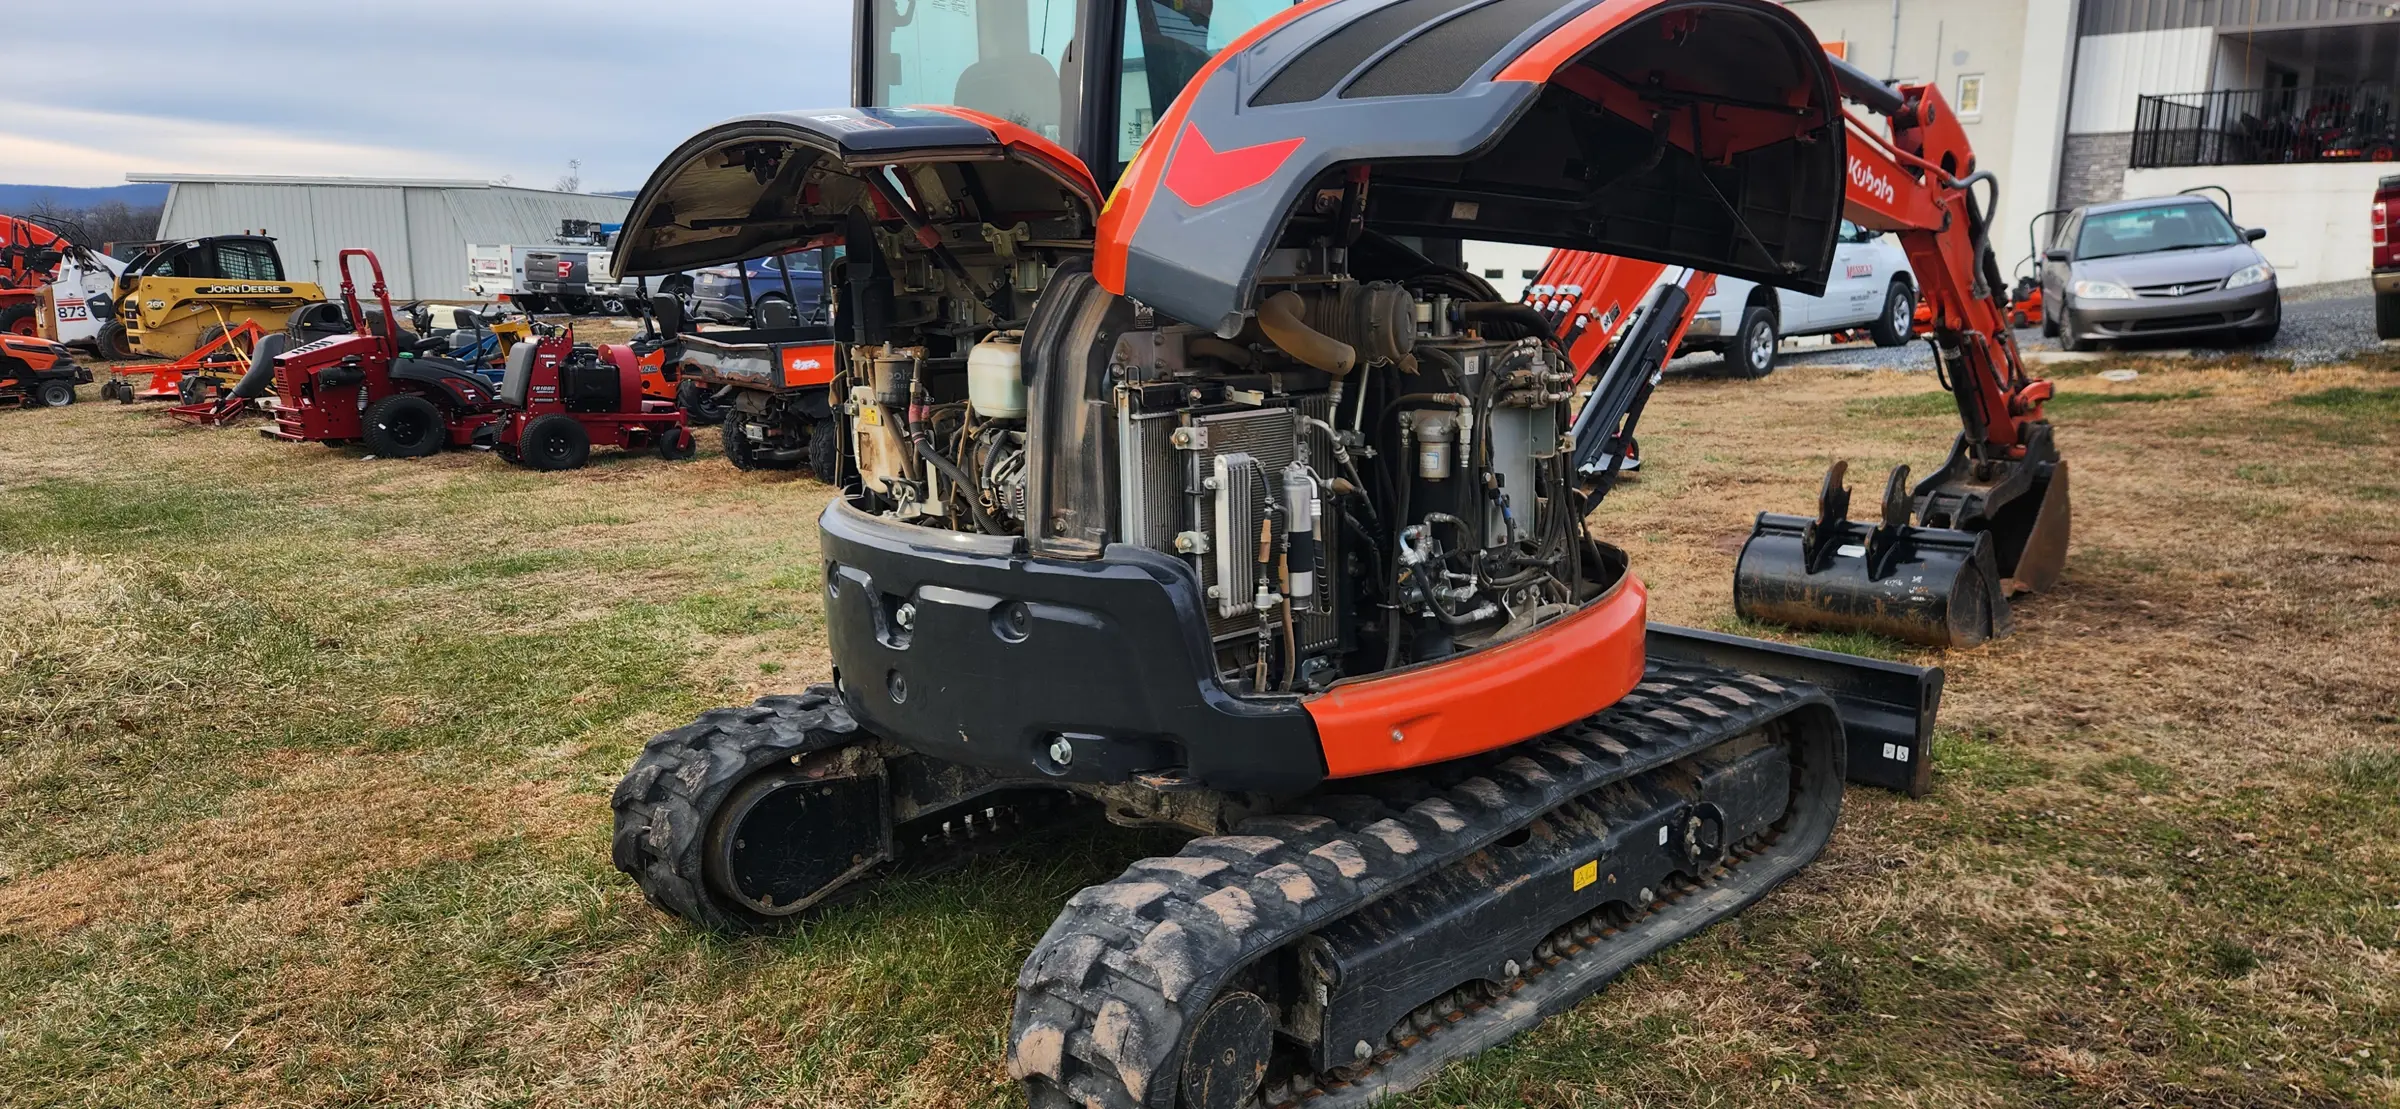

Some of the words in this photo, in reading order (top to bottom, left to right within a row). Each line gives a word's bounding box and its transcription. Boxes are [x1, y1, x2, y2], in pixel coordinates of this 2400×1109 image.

[1849, 155, 1894, 205] Kubota
[207, 284, 240, 294] JOHN
[241, 284, 281, 293] DEERE
[58, 306, 87, 318] 873
